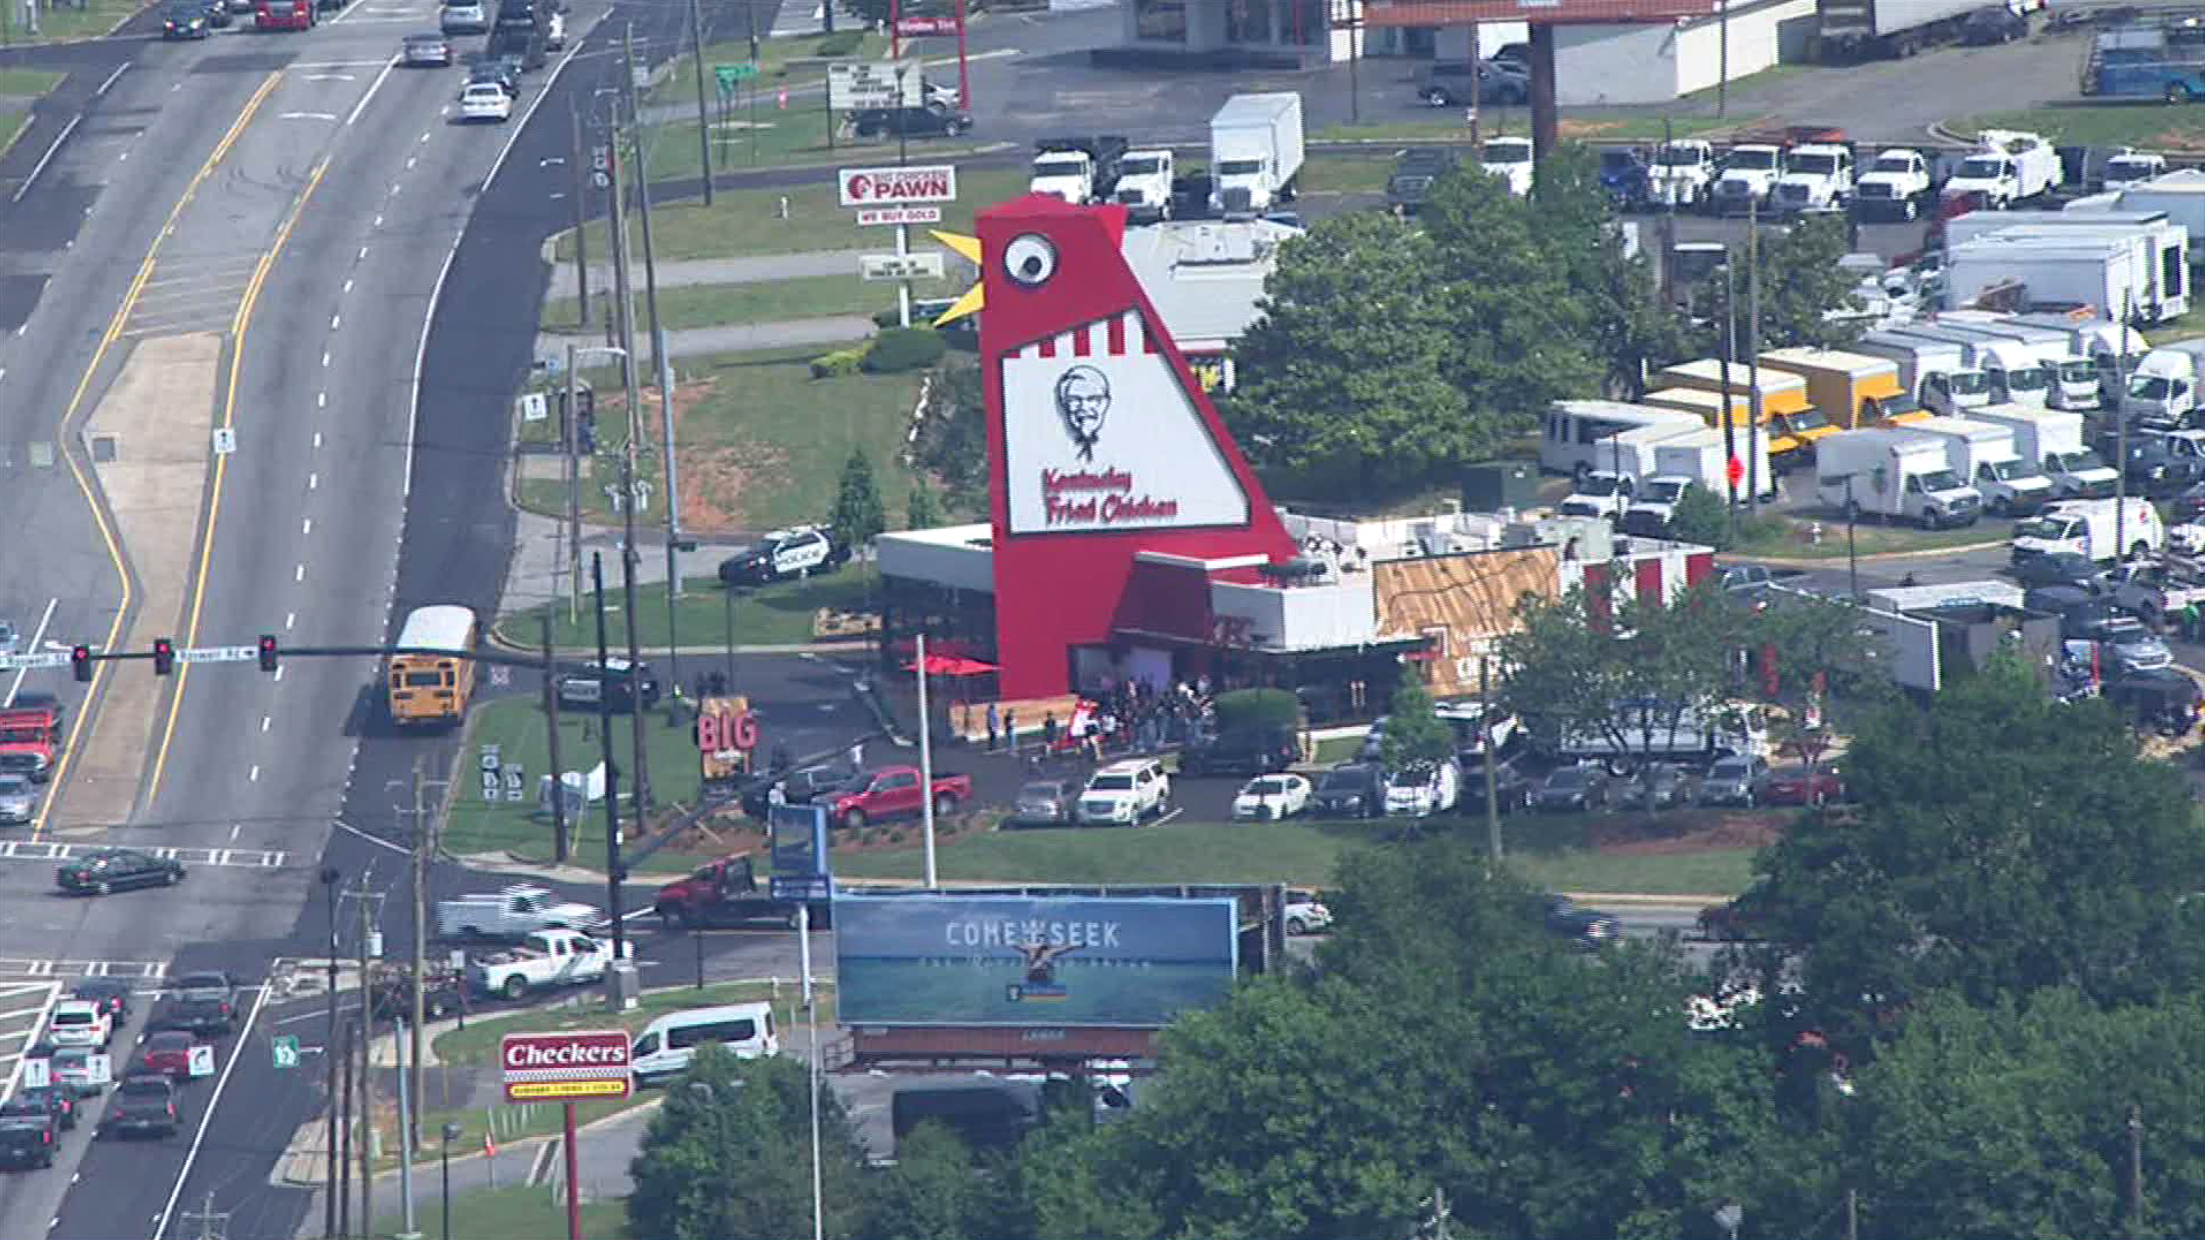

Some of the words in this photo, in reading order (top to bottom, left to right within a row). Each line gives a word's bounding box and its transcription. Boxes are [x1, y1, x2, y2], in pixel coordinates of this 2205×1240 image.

[875, 182, 948, 198] PAWN
[906, 210, 938, 220] GOLD
[1042, 466, 1131, 494] Kentucky
[1045, 495, 1096, 524] Fried
[1101, 493, 1178, 523] Chicken
[698, 715, 757, 752] BIG
[946, 921, 1017, 946] COME
[1050, 921, 1121, 947] SEEK
[507, 1043, 625, 1066] Checkers
